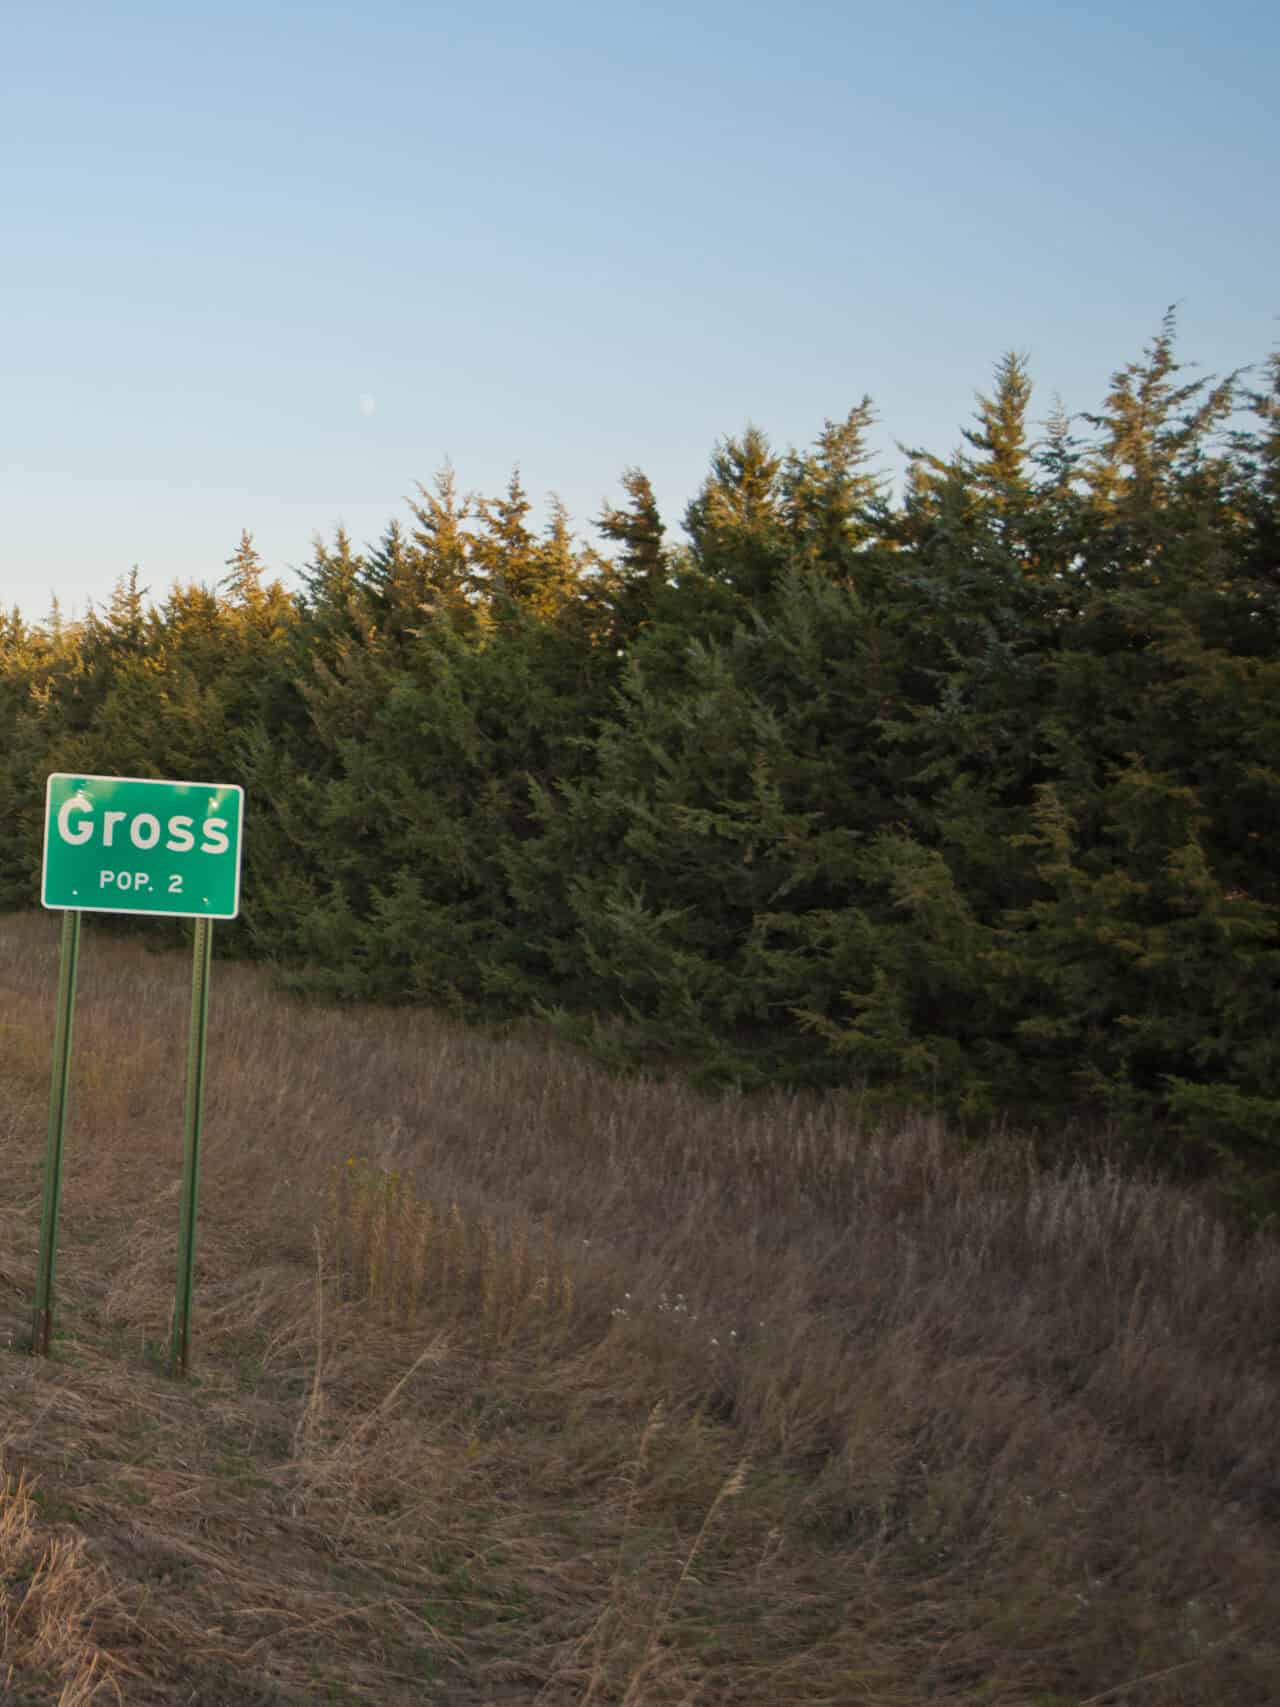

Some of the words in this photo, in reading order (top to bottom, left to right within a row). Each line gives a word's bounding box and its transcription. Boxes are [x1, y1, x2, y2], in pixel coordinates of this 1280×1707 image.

[57, 797, 230, 855] Gross
[99, 869, 154, 892] POP.
[167, 873, 184, 894] 2
